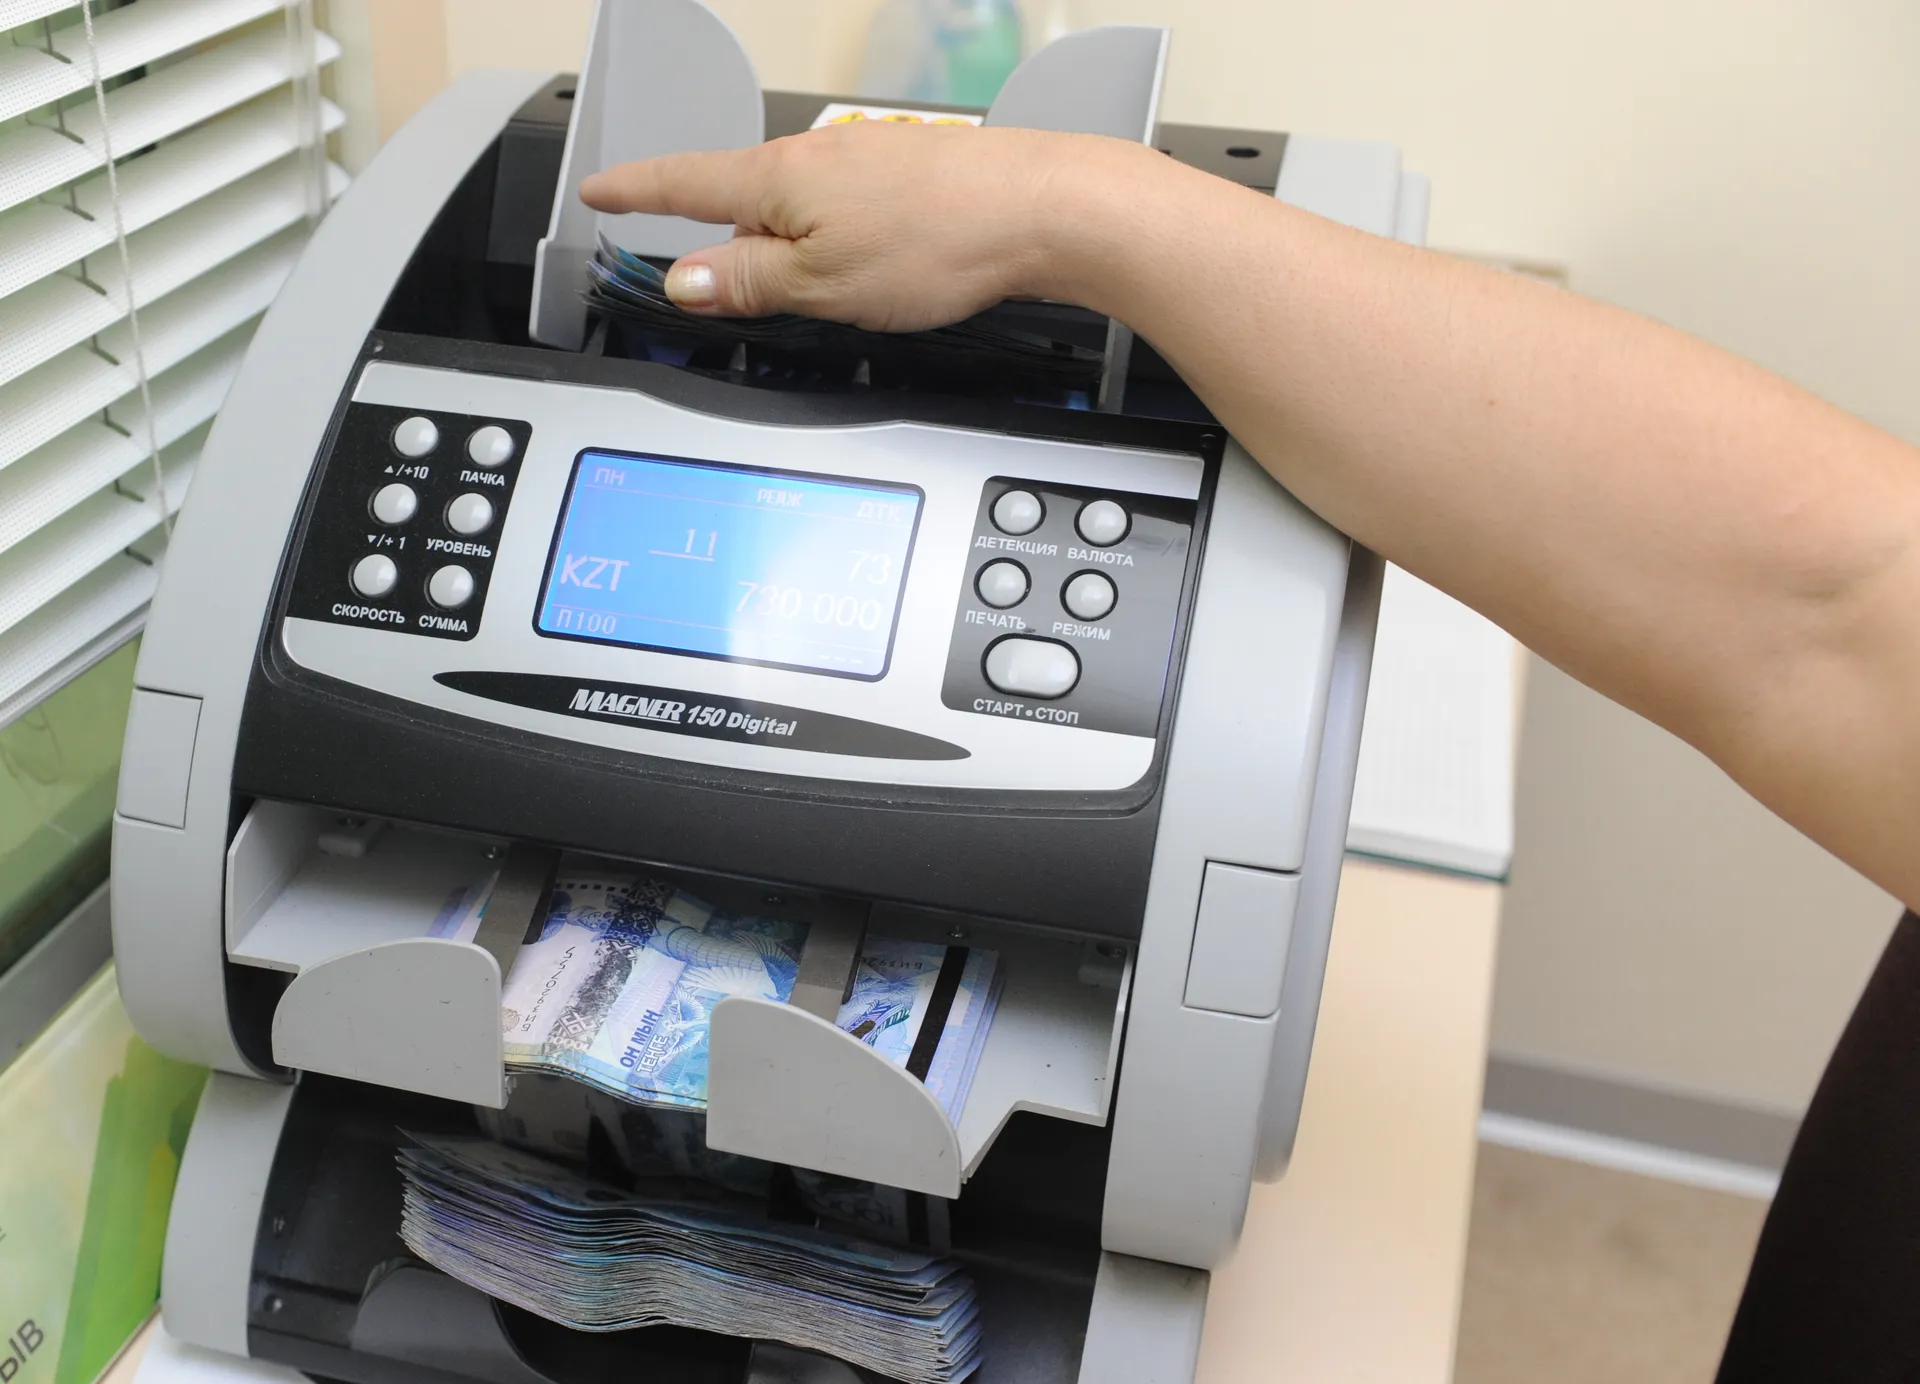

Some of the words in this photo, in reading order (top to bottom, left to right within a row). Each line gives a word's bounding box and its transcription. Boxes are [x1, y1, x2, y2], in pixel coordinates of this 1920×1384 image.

[459, 470, 505, 487] ПАЧКА
[595, 467, 625, 486] ПН
[857, 501, 904, 521] ДТК
[426, 538, 492, 558] УРОВЕНЬ
[684, 528, 718, 558] 11
[974, 535, 1058, 556] ДЕТЕКЦИЯ
[850, 550, 892, 586] 73
[1067, 548, 1134, 567] ВАЛЮТА
[560, 552, 629, 592] KZT
[332, 603, 406, 624] СКОРОСТЬ
[418, 615, 469, 633] СУММА
[556, 608, 616, 635] П100
[964, 610, 1027, 631] ПЕЧАТЬ
[1052, 621, 1112, 641] РЕЖИМ
[568, 688, 687, 724] MAGNER
[687, 704, 727, 727] 150
[726, 712, 798, 737] Digital
[620, 1045, 641, 1068] ОН
